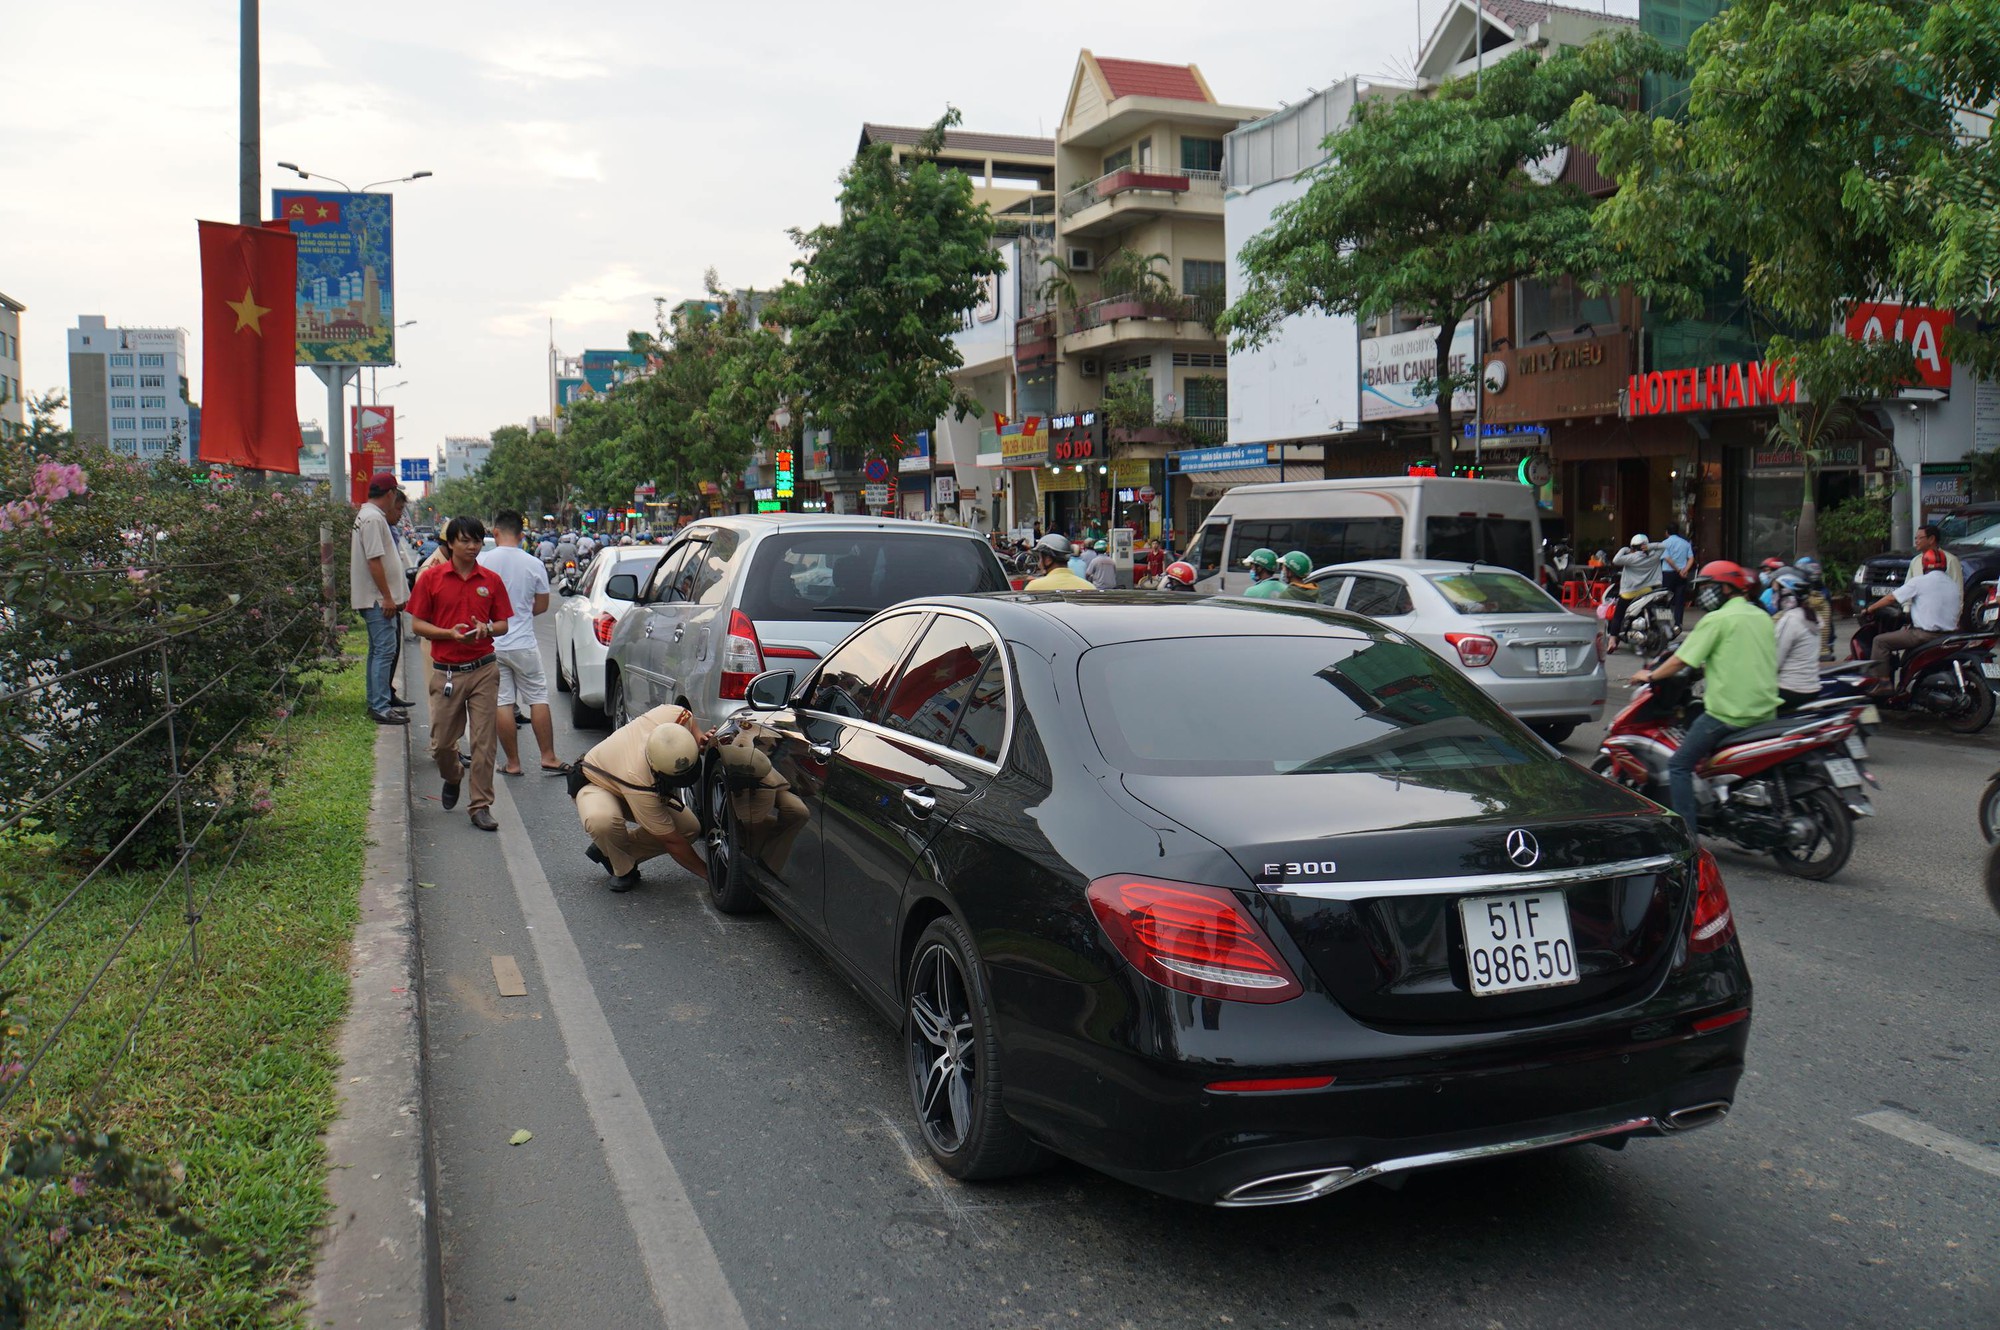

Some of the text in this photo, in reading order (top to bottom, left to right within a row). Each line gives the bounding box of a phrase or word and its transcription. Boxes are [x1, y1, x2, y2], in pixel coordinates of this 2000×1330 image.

[1391, 341, 1404, 357] GIA
[1367, 361, 1399, 386] BÁNH
[1403, 357, 1437, 381] CANH
[1629, 367, 1704, 416] HOTEL
[1055, 431, 1072, 460] SỐ
[1074, 430, 1092, 458] ĐỎ
[1544, 648, 1560, 661] 51F
[1264, 861, 1337, 875] E 300
[1488, 898, 1539, 941] 51F
[1472, 938, 1572, 987] 986.50
